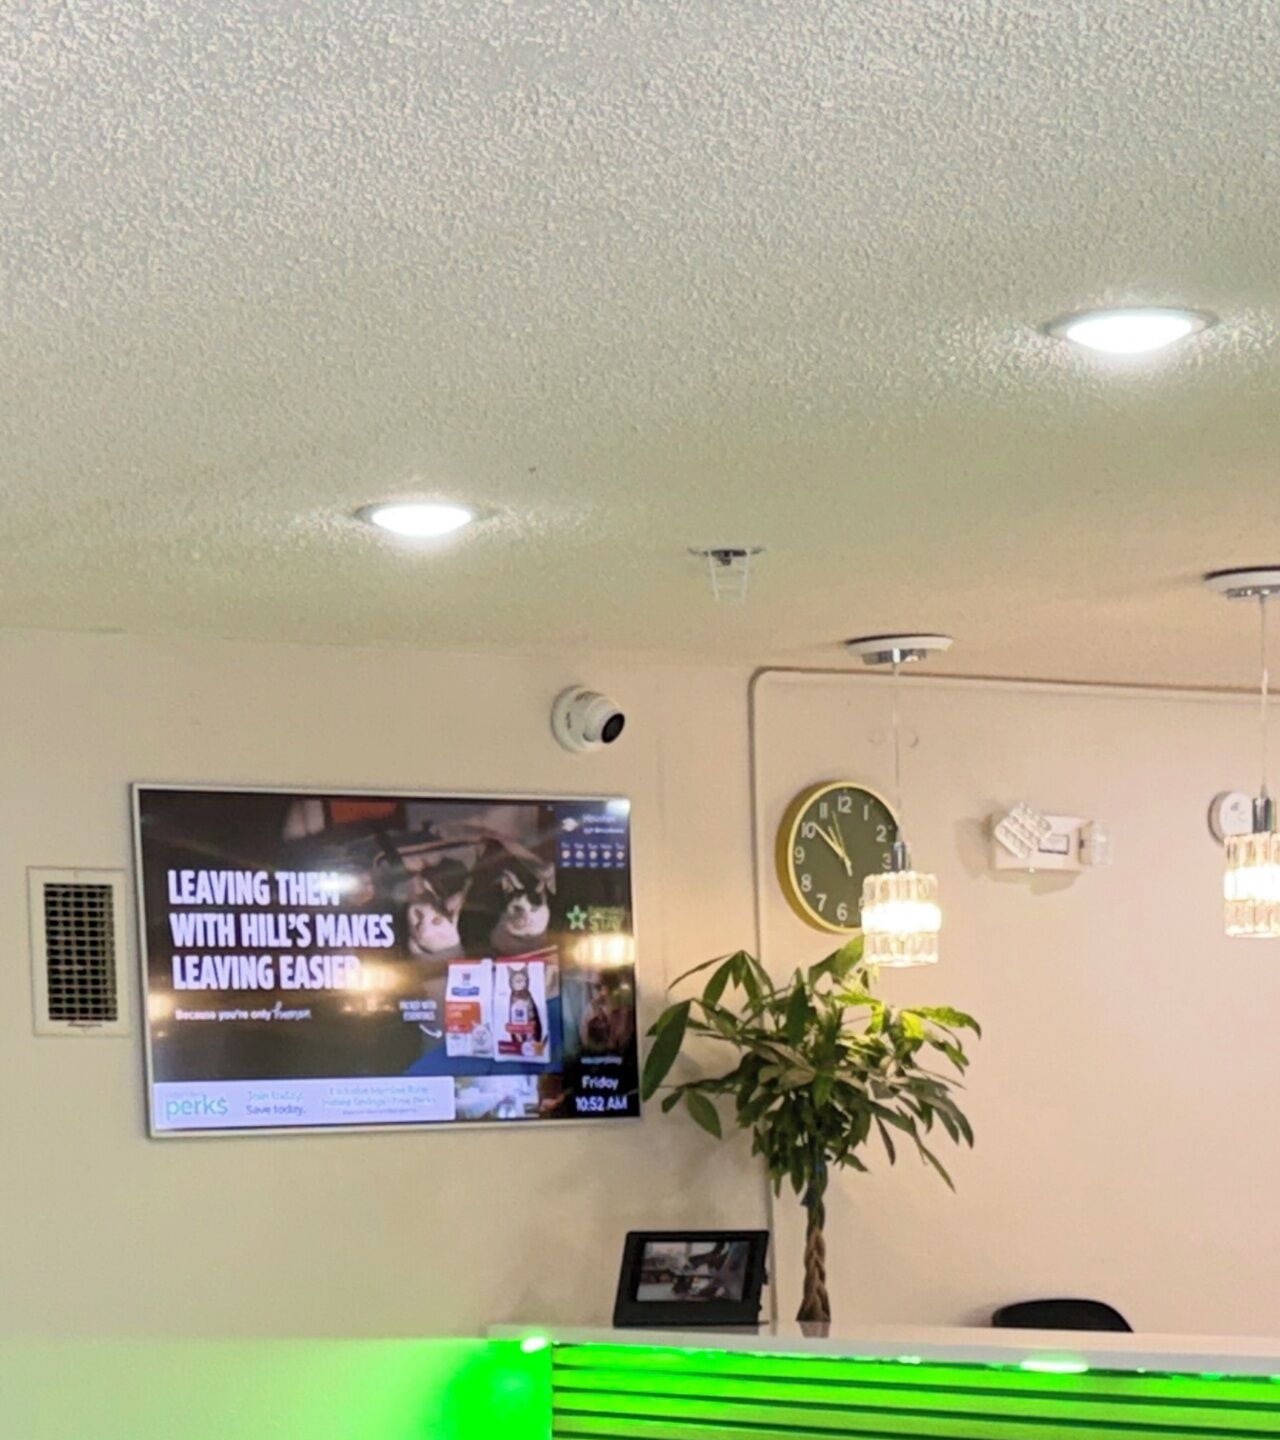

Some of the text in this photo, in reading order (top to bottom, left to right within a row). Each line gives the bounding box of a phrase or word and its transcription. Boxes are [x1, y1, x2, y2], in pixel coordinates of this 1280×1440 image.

[819, 802, 828, 818] 11
[837, 796, 852, 813] 12
[863, 804, 869, 821] 1
[801, 821, 816, 839] 10
[875, 824, 887, 842] 2
[795, 847, 805, 864] 9
[882, 853, 891, 869] 3
[168, 869, 341, 906] LEAVING THEM
[801, 873, 812, 892] 8
[816, 894, 827, 912] 7
[836, 902, 848, 921] 6
[169, 912, 395, 948] WITH HILL'S MAKES
[172, 955, 275, 990] LEAVING
[582, 1075, 619, 1091] Friday
[166, 1094, 228, 1120] perks
[246, 1104, 271, 1116] Save
[575, 1095, 628, 1112] 10:52 AM
